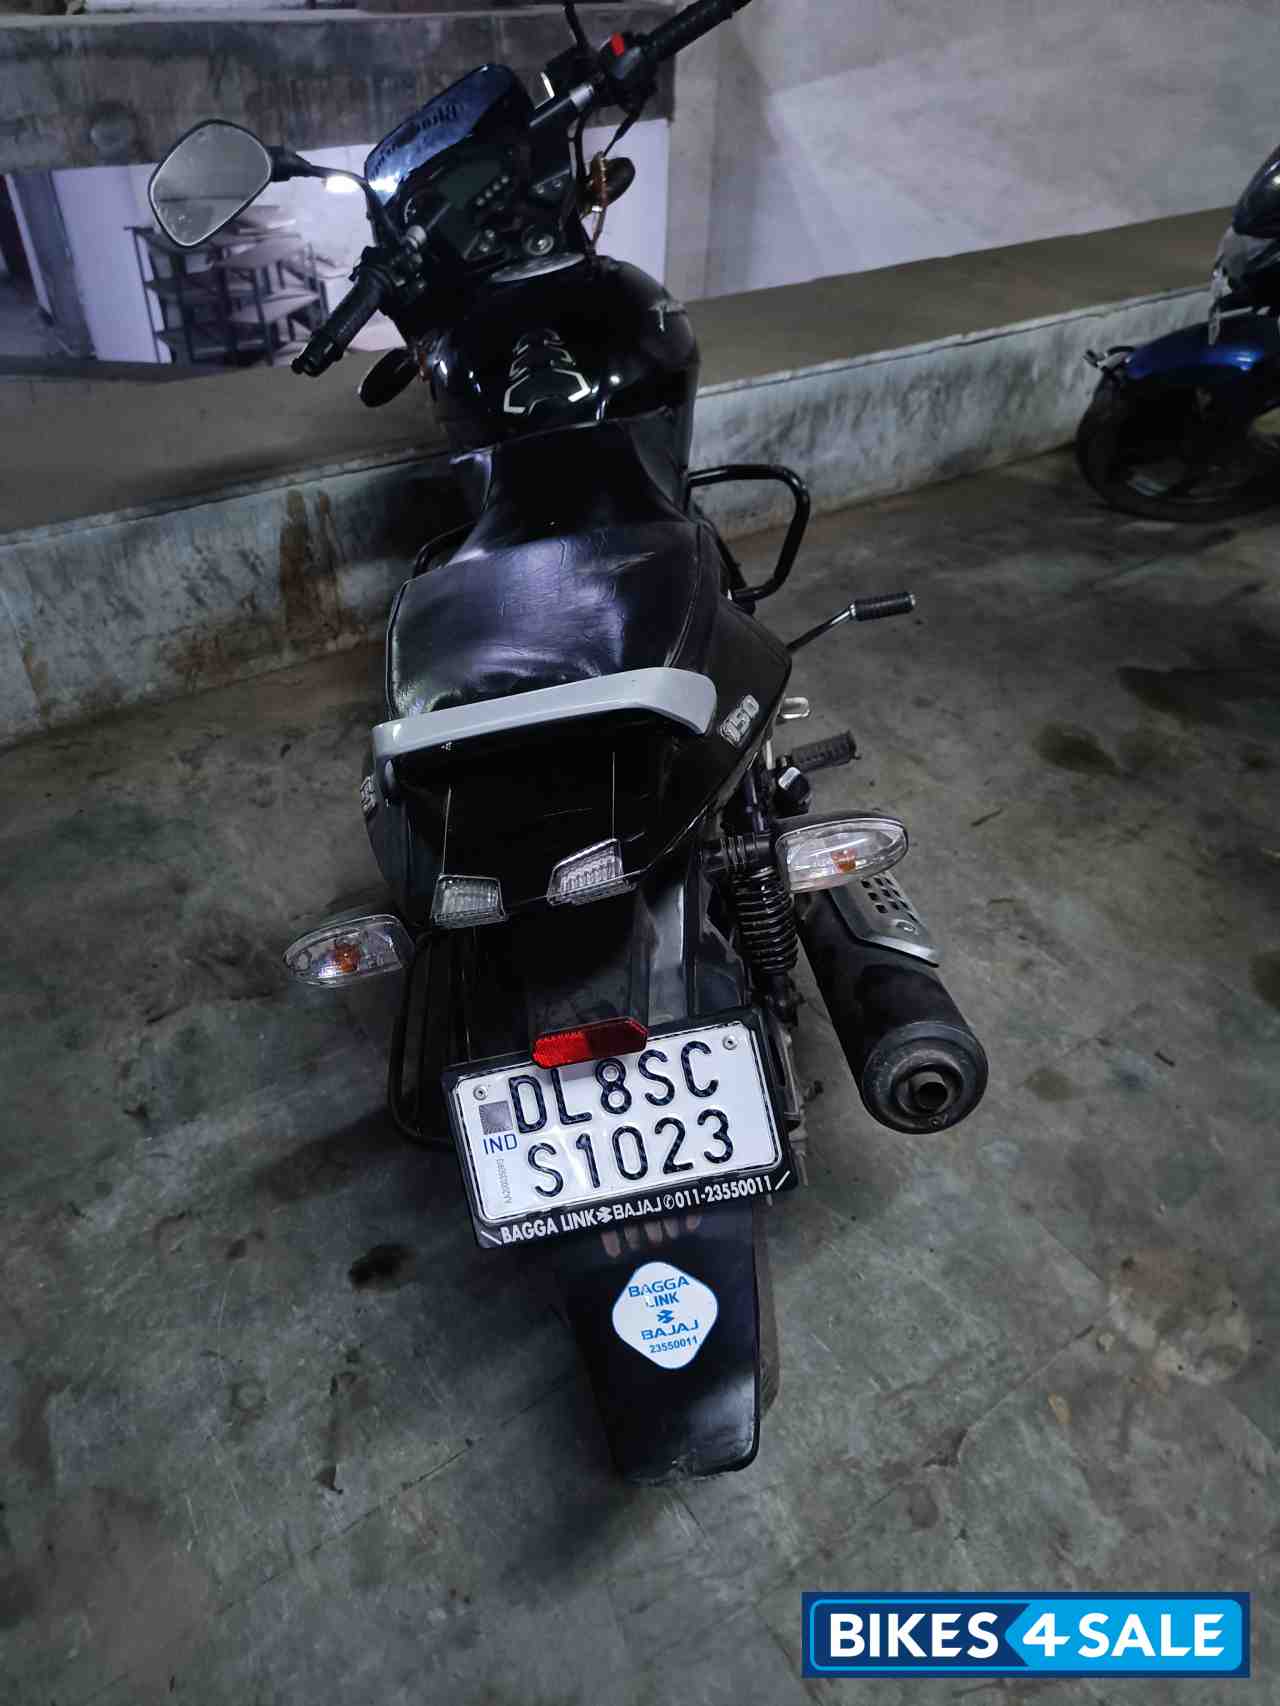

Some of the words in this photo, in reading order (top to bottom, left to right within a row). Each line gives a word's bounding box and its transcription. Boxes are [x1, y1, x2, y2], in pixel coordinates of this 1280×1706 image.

[483, 1133, 518, 1154] IND
[527, 1107, 734, 1198] S1023
[500, 1216, 559, 1244] BAGGA
[561, 1208, 600, 1231] LINK
[612, 1196, 662, 1221] BAJAJ
[674, 1175, 772, 1209] 011-23550011
[628, 1275, 690, 1298] BAGGA
[640, 1319, 700, 1341] BAJAJ
[648, 1335, 698, 1354] 23550011
